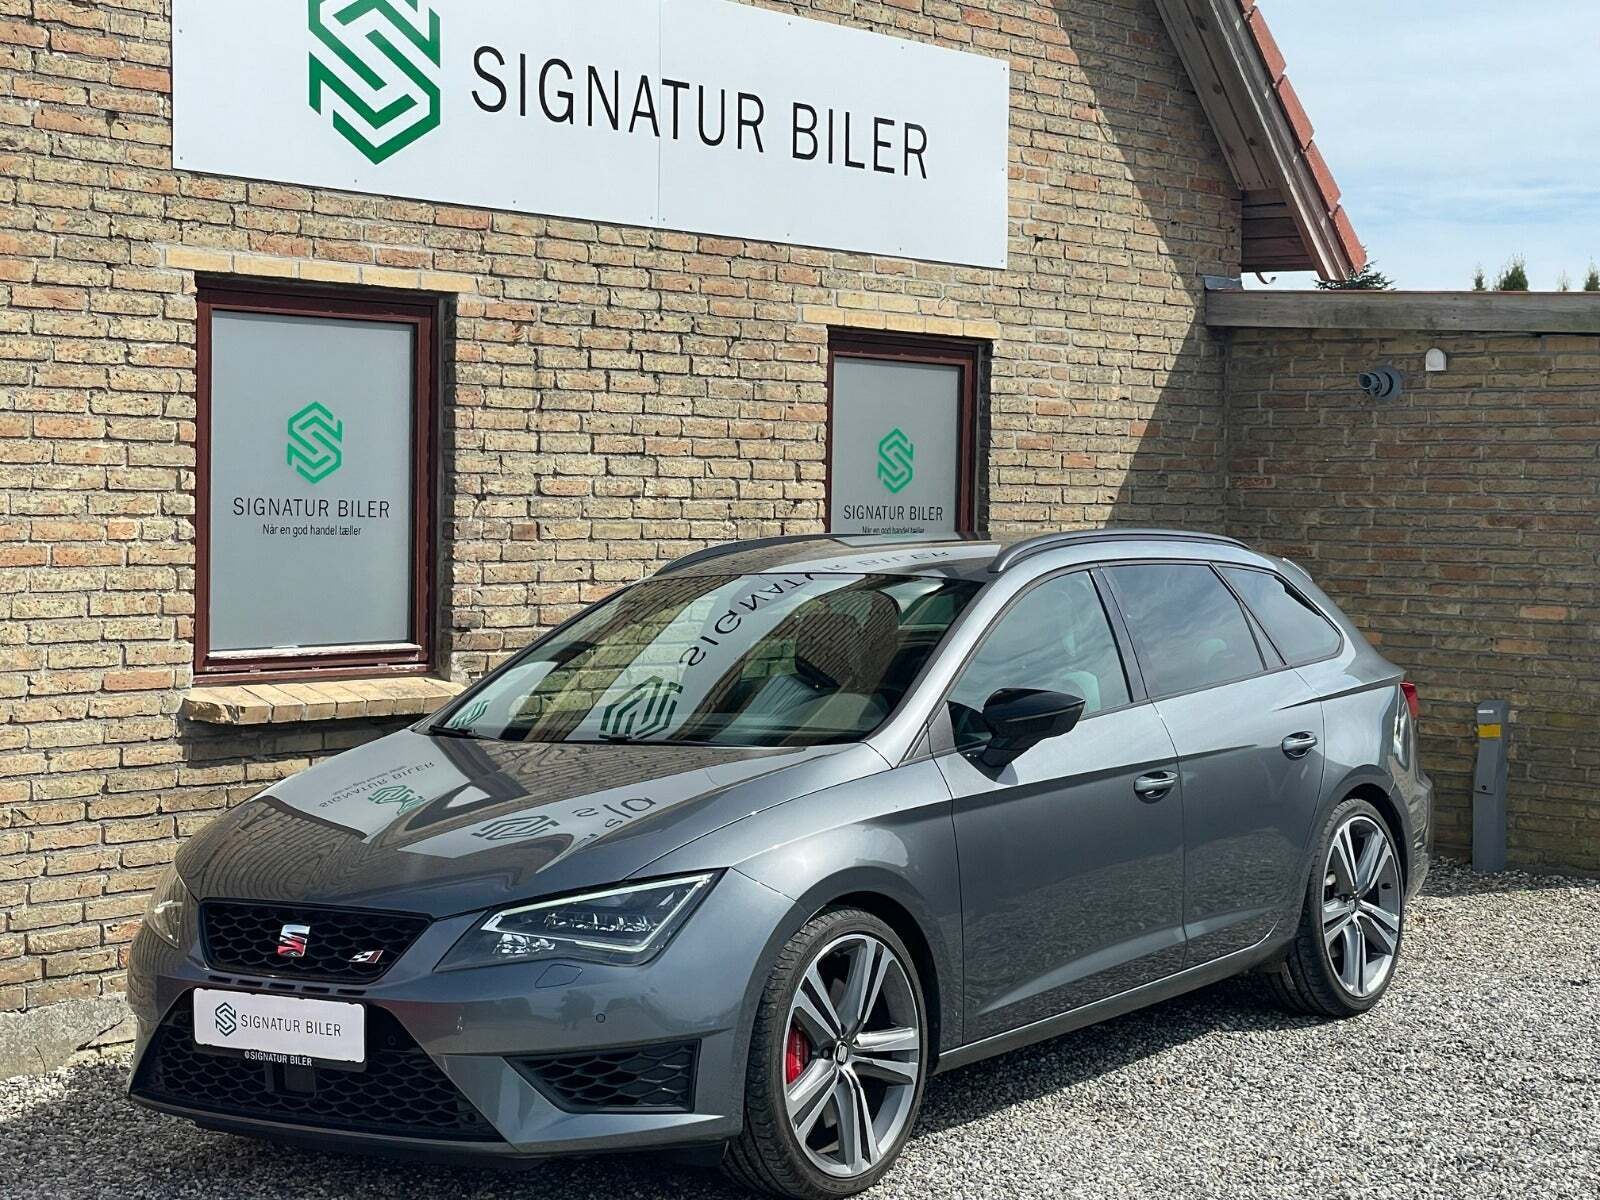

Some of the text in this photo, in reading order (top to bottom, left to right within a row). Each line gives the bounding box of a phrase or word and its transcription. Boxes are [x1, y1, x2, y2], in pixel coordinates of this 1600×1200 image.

[471, 45, 928, 180] SIGNATUR BILER
[232, 497, 390, 519] SIGNATUR BILER
[843, 504, 944, 521] SIGNATUR BILER
[280, 525, 290, 535] en
[292, 524, 308, 537] god
[310, 524, 337, 536] handel
[339, 525, 361, 536] tæller
[240, 1014, 341, 1037] SIGNATUR BILER
[290, 1055, 313, 1067] BILER
